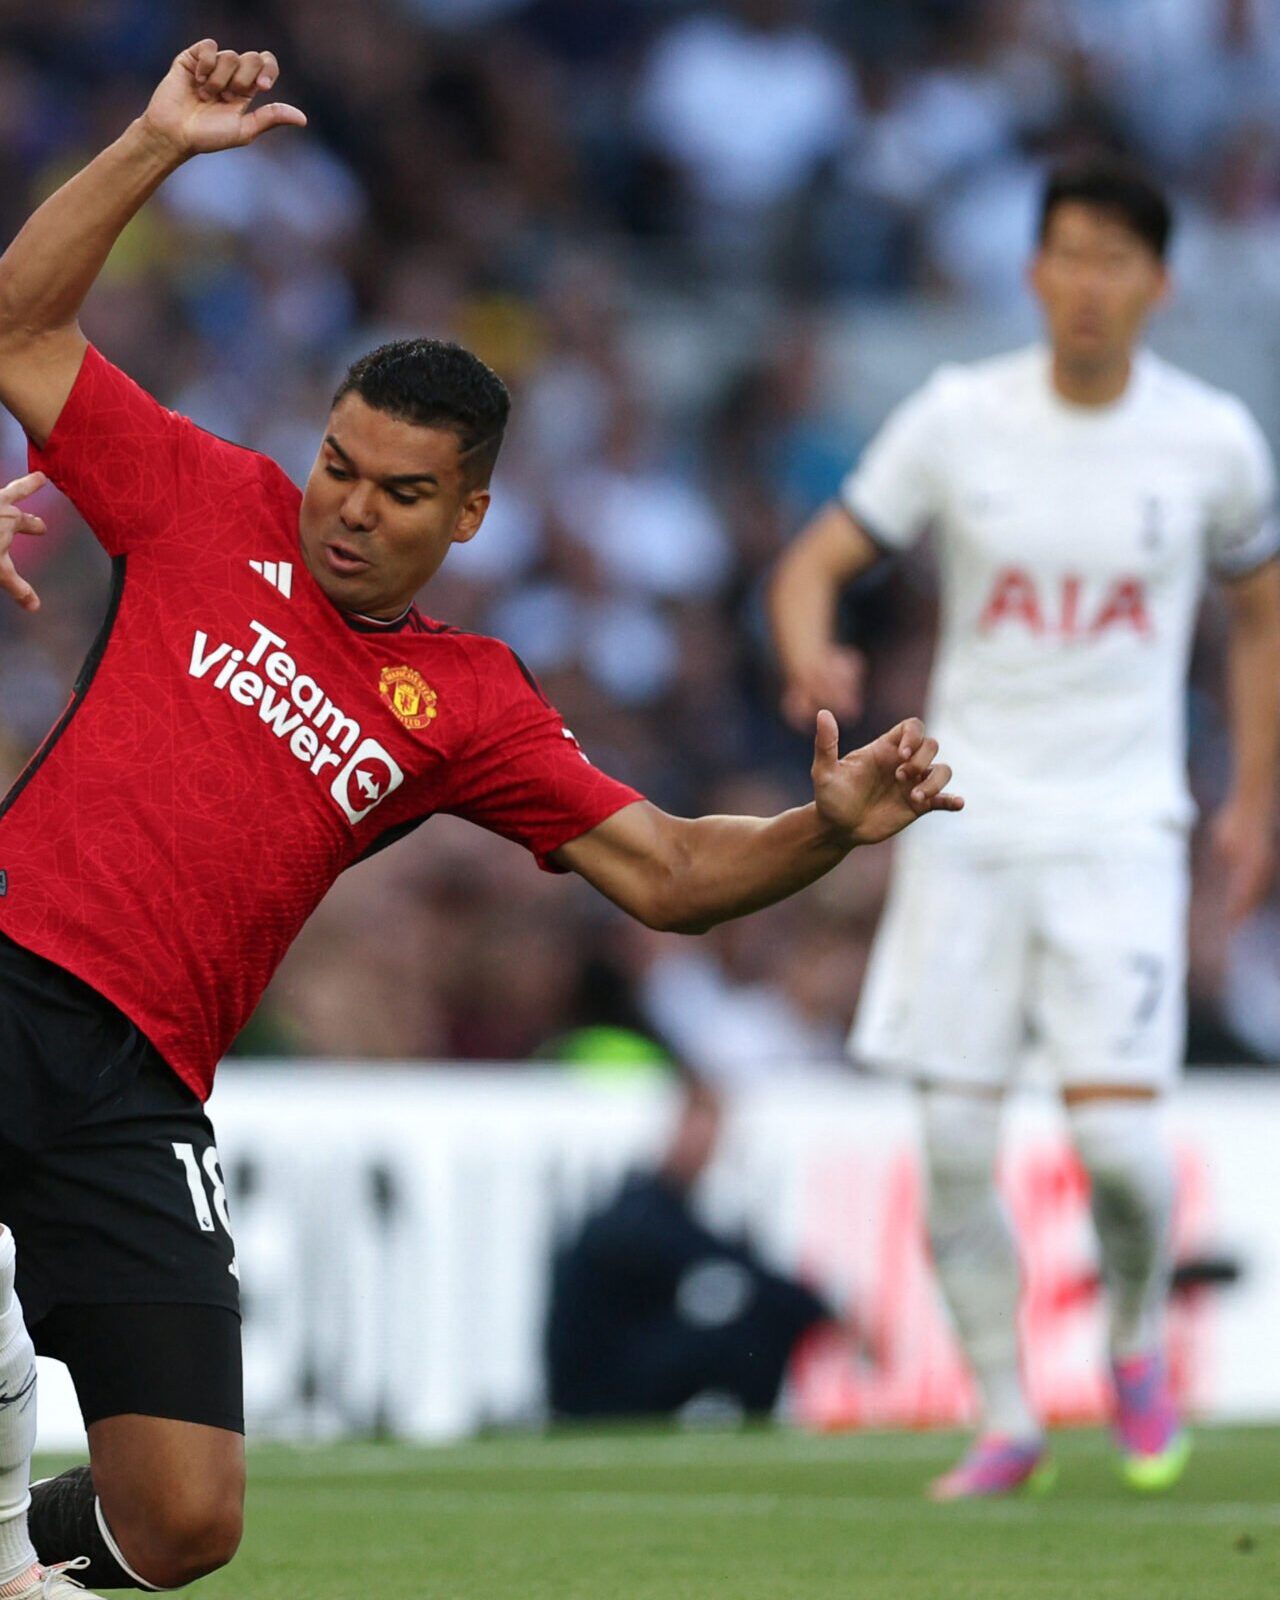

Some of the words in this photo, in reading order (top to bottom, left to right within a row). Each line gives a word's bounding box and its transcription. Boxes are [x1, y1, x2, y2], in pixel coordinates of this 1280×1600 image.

[975, 563, 1156, 642] AIA
[188, 629, 342, 776] Viewer
[246, 619, 361, 754] Team
